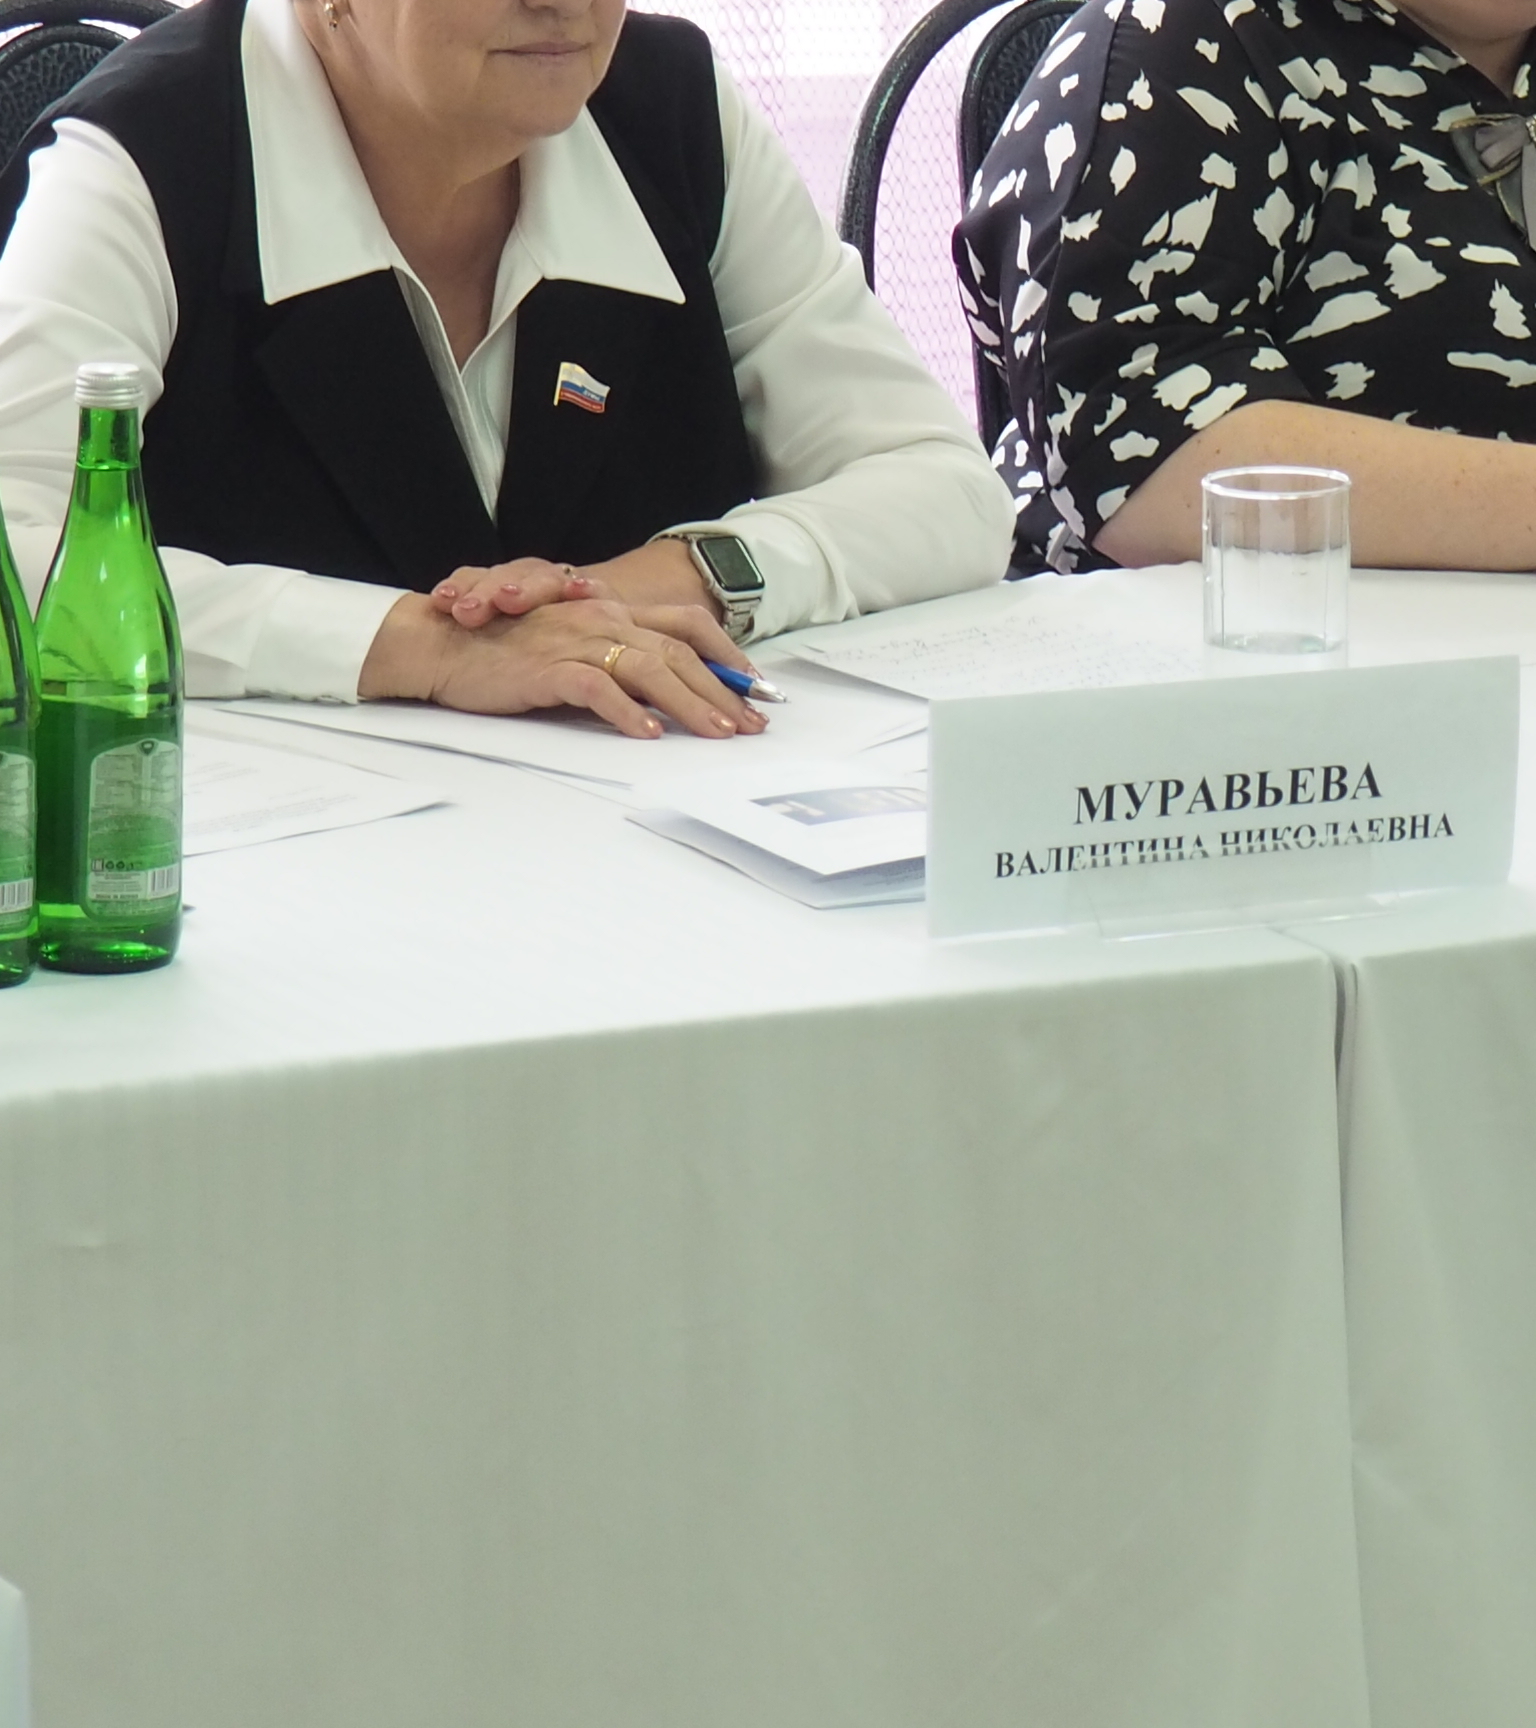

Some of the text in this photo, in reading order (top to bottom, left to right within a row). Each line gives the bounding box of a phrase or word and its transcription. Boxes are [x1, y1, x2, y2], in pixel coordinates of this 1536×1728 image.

[1074, 762, 1383, 825] МУРАВЬЕВА
[995, 812, 1455, 879] ВАЛЕНТИНА НИКОЛАЕВНА
